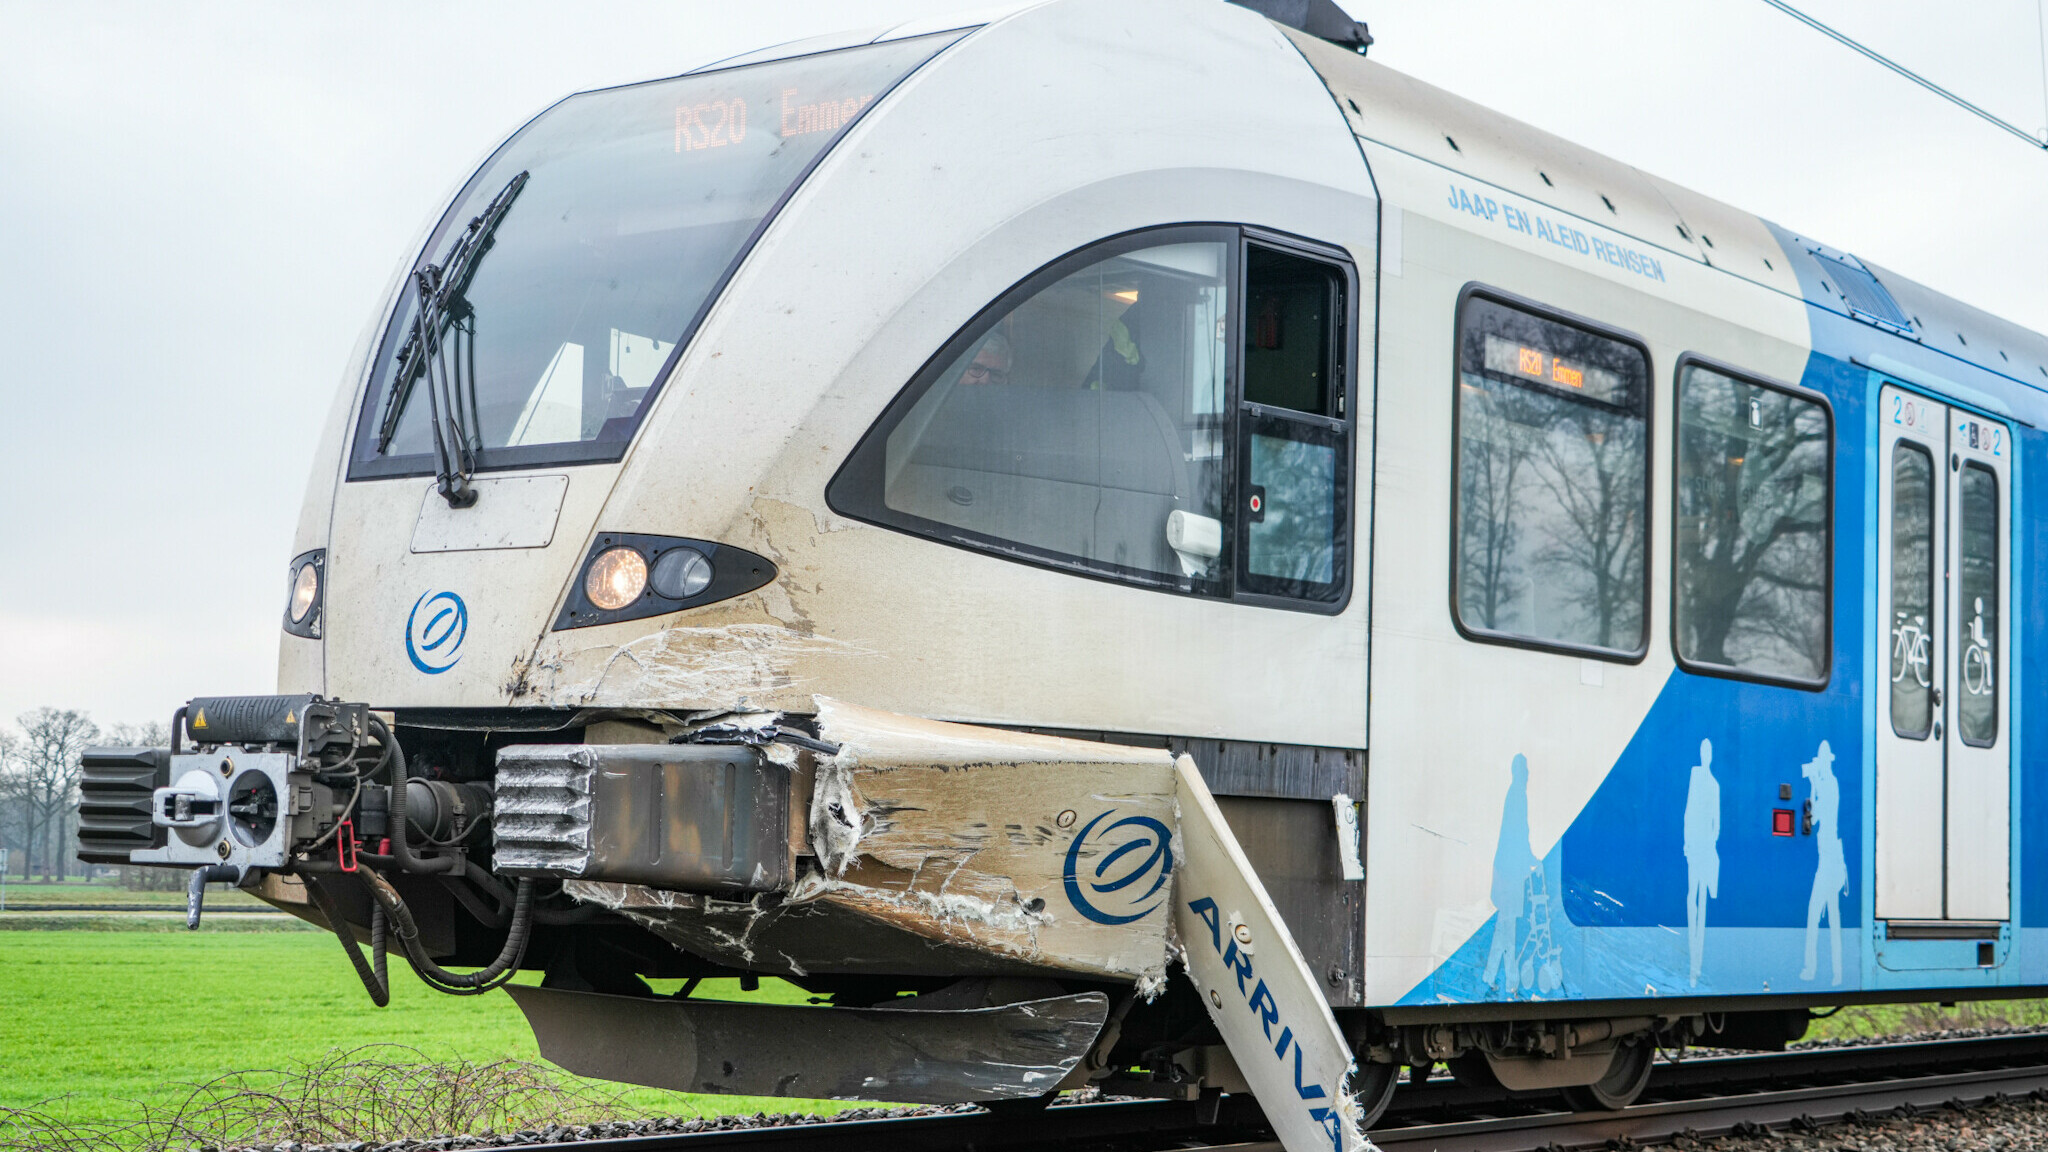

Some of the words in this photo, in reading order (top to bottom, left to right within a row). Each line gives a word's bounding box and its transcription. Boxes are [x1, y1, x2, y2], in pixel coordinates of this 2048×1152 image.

[675, 97, 747, 153] RS20
[1448, 185, 1499, 222] JAAP
[1502, 204, 1533, 236] EN
[1536, 216, 1590, 255] ALEID
[1592, 236, 1666, 283] RENSEN
[1519, 347, 1542, 376] RS20
[1552, 357, 1583, 388] Emmen
[1893, 395, 1902, 424] 2
[1993, 429, 2001, 456] 2
[1188, 896, 1342, 1152] ARRIVA
